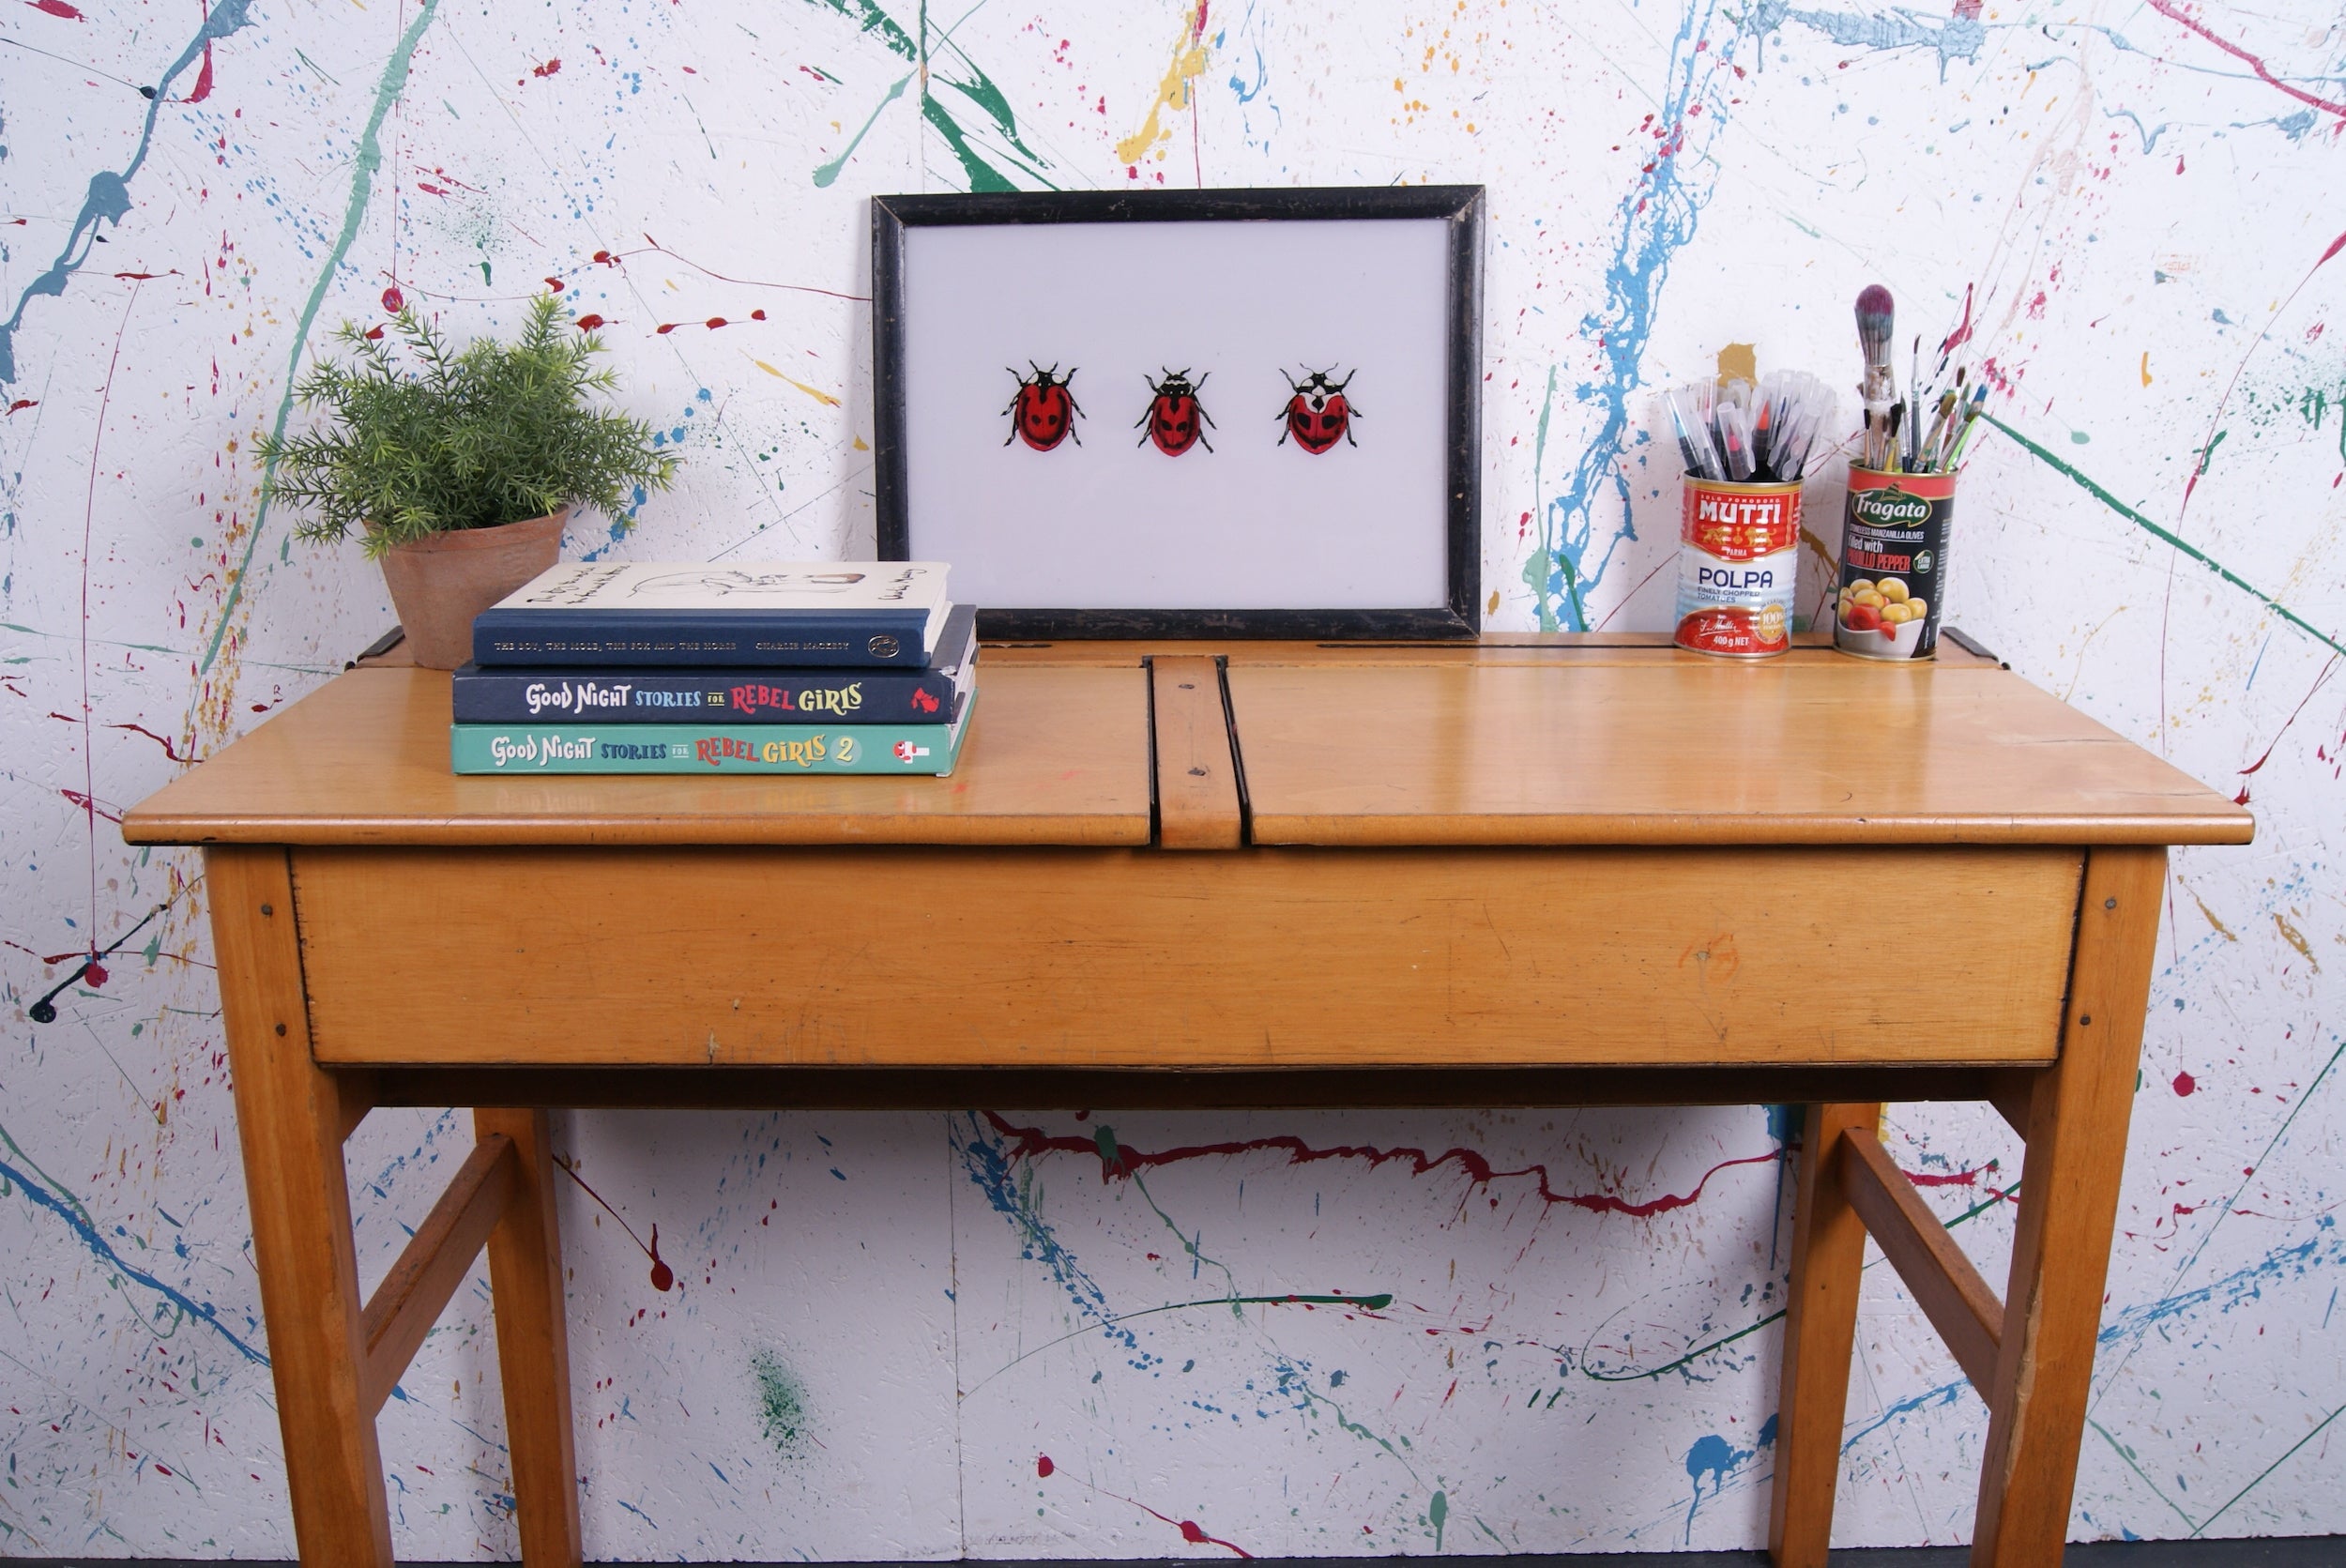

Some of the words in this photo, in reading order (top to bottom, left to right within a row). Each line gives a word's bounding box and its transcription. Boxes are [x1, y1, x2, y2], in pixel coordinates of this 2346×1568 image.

[1699, 500, 1781, 525] MUTTI
[1856, 492, 1927, 521] Fragata
[1870, 528, 1906, 540] MANZANILLA
[1905, 531, 1925, 540] OLIVES
[1864, 537, 1883, 554] with
[1877, 553, 1911, 571] PEPPER
[1699, 567, 1774, 588] POLPA
[1697, 586, 1721, 595] FINELY
[494, 642, 514, 651] THE
[546, 642, 567, 651] THE
[605, 642, 627, 651] THE
[654, 642, 676, 651] AND
[678, 642, 700, 651] THE
[1714, 635, 1728, 644] 400
[1728, 638, 1734, 647] g
[1734, 636, 1750, 646] NET
[635, 690, 702, 708] STORIES
[708, 694, 725, 704] FOR
[730, 684, 796, 715] REBEL
[601, 743, 667, 760] STORIES
[672, 747, 690, 755] FOR
[694, 737, 760, 767] REBEL
[836, 738, 854, 762] 2
